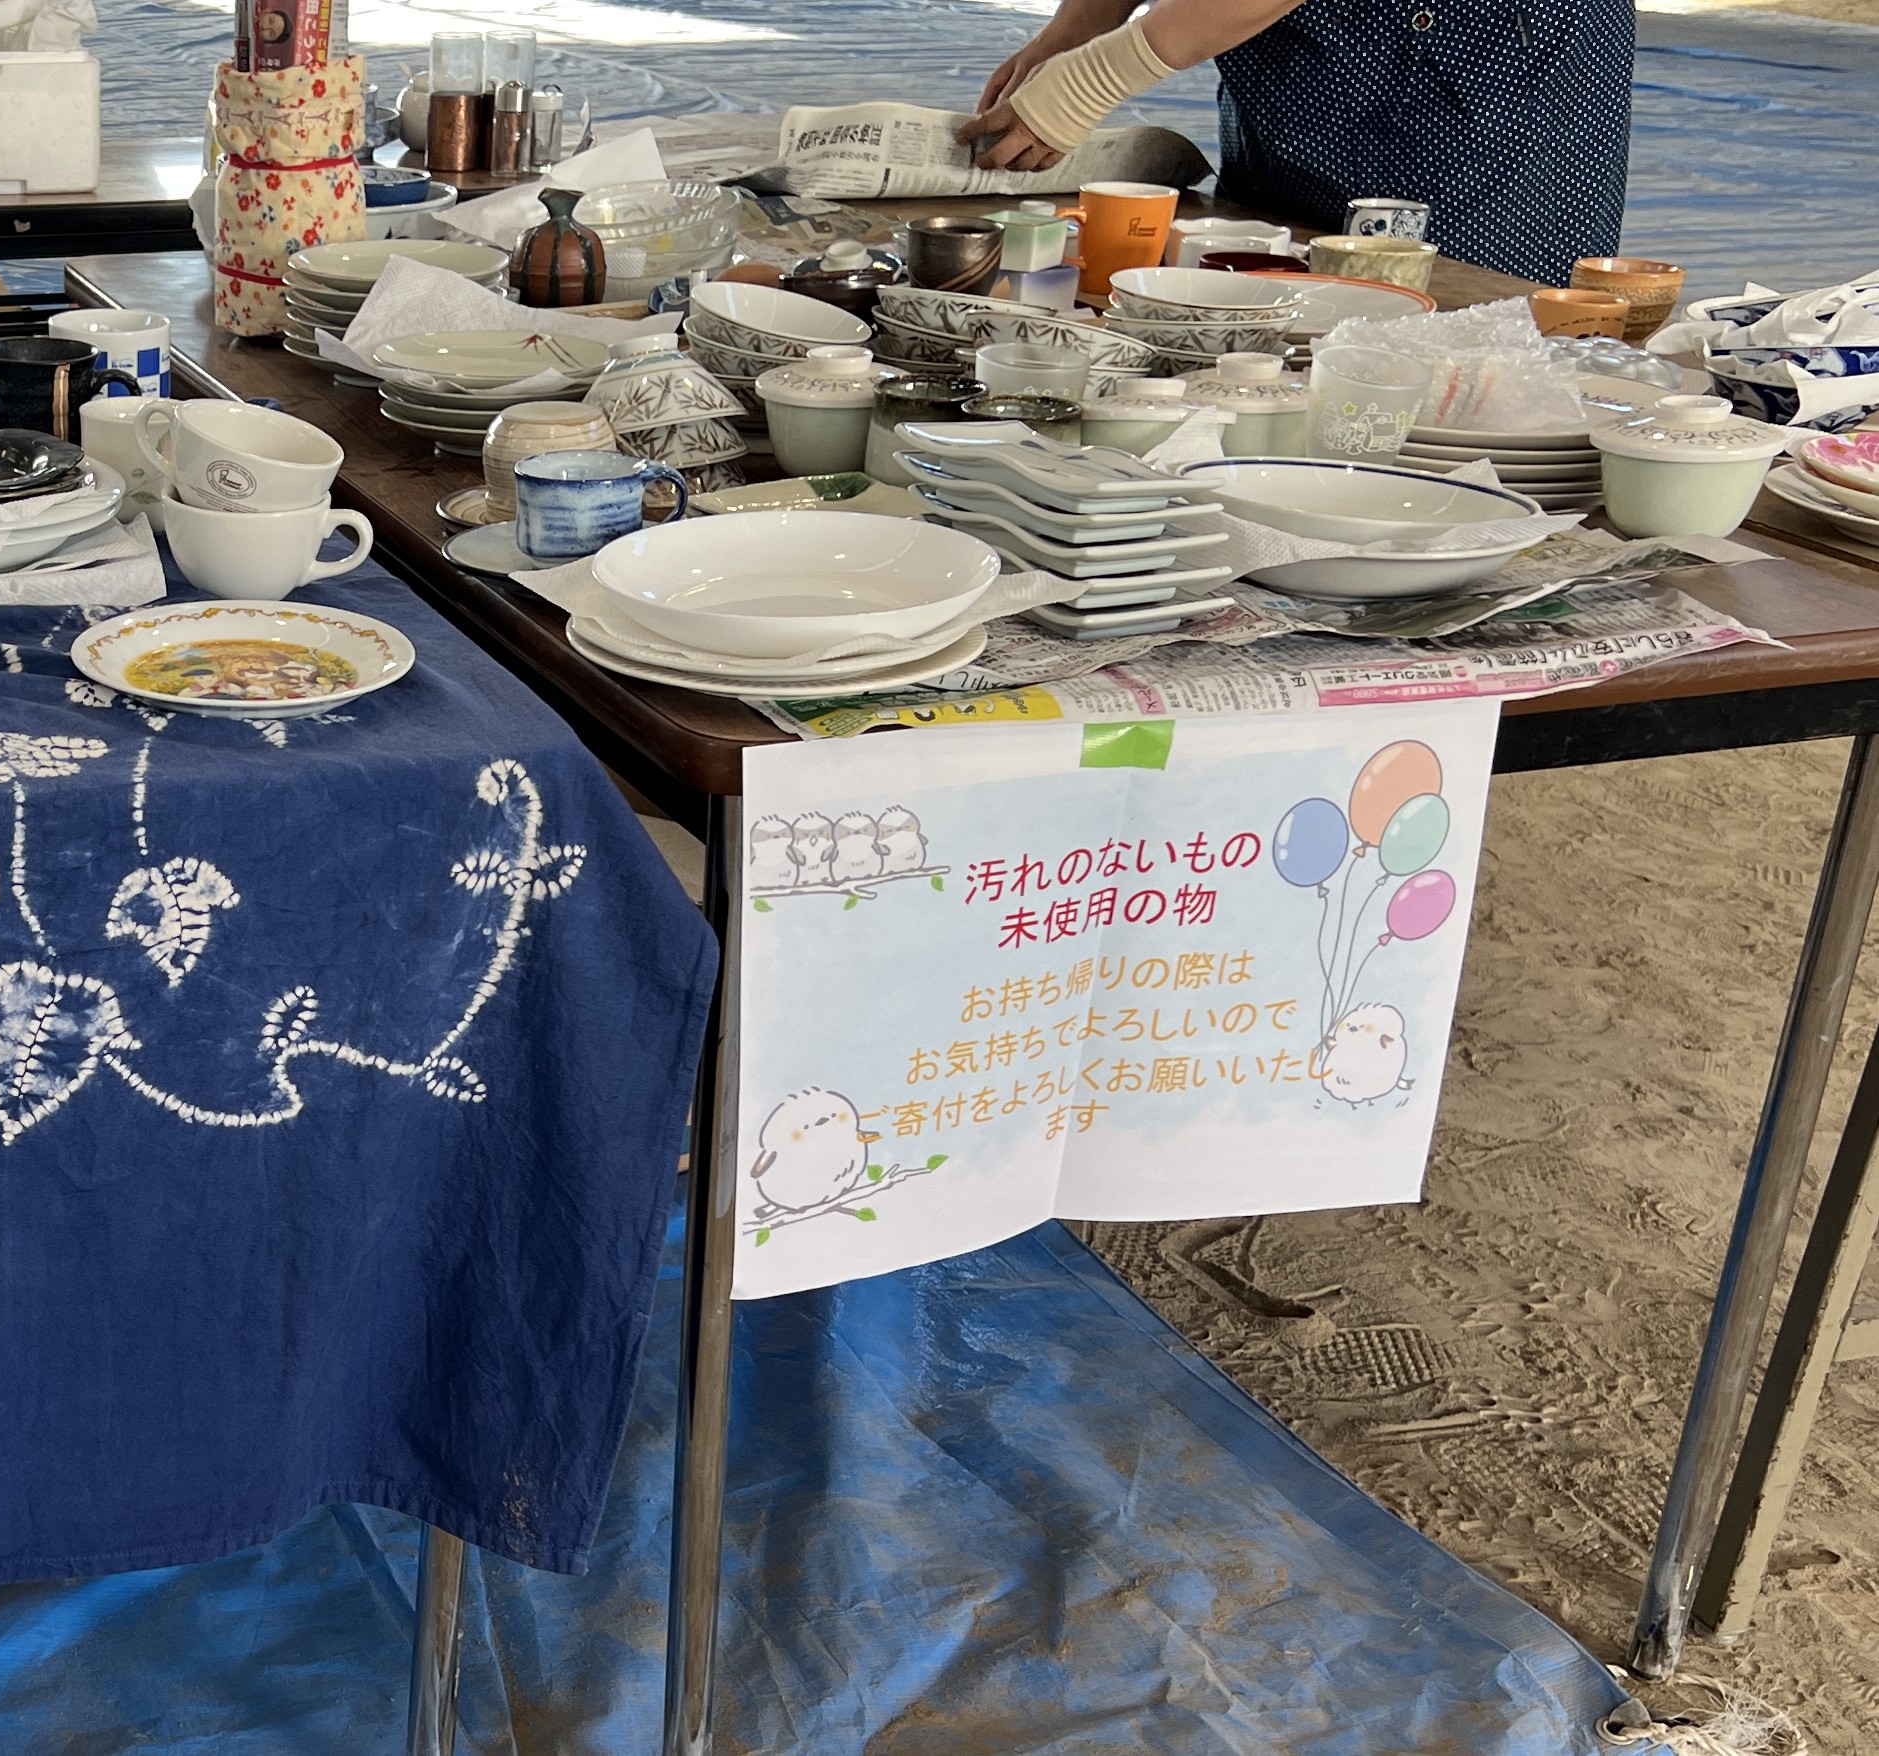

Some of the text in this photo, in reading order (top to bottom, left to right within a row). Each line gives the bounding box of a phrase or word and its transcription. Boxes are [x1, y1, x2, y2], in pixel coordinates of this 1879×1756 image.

[964, 831, 1262, 905] 汚れのないもの
[997, 882, 1218, 949] 未使用の物
[959, 949, 1256, 1023] お持ち帰りの際は
[905, 998, 1298, 1086] お気持ちでよろしいので
[858, 1046, 1334, 1144] ご寄付をよろしくお願いいたし
[1044, 1100, 1110, 1141] ます
